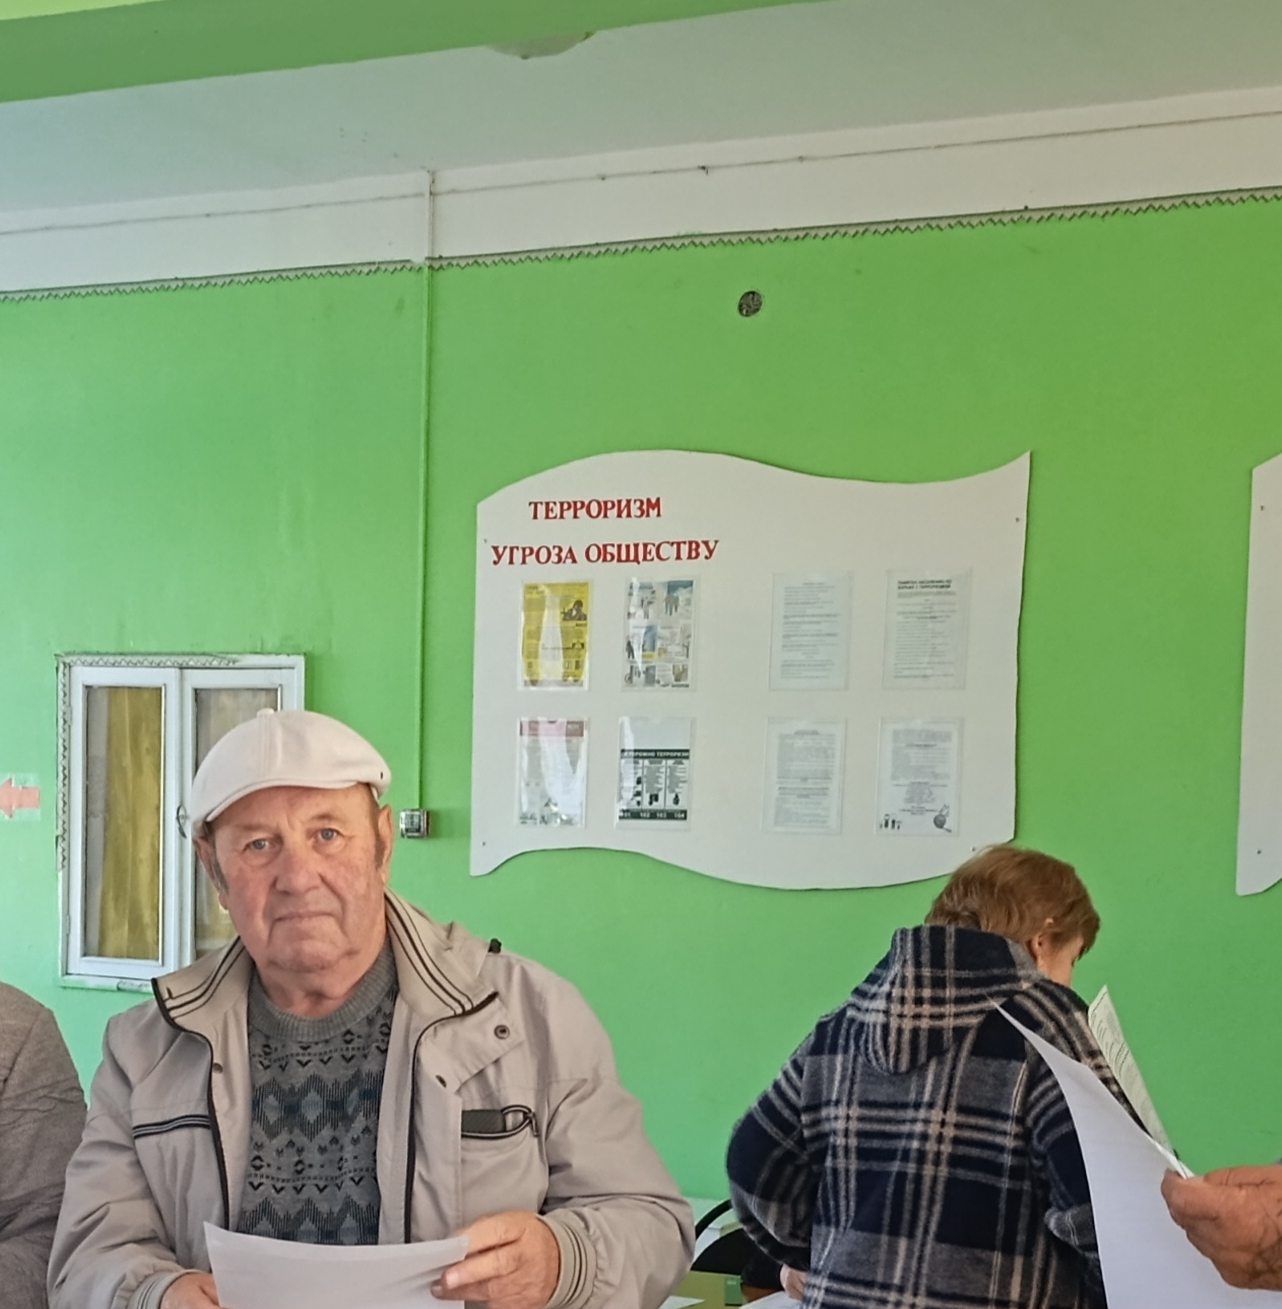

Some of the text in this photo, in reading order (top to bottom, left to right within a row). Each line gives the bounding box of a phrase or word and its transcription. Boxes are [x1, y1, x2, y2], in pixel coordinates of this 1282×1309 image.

[529, 497, 662, 520] ТЕРРОРИЗМ
[491, 540, 719, 565] УГРОЗА ОБЩЕСТВУ
